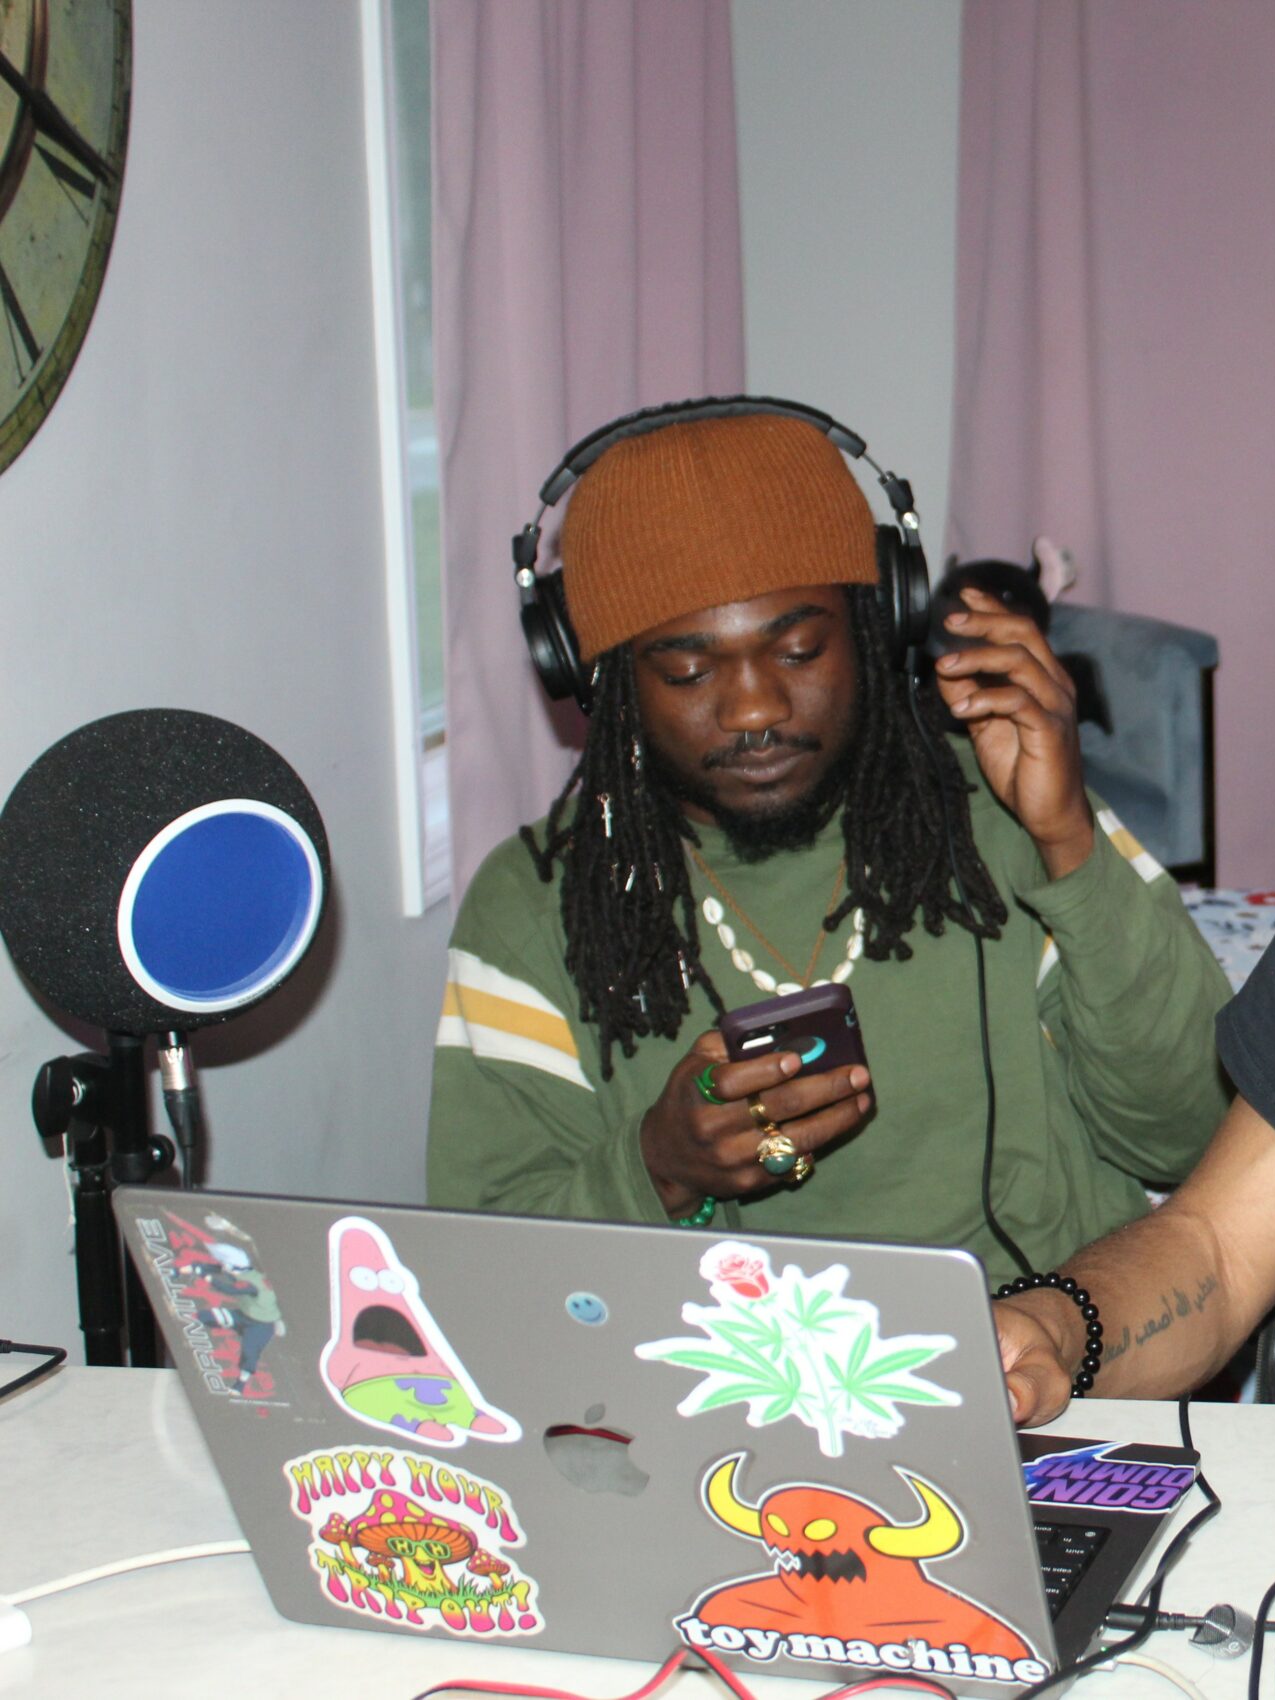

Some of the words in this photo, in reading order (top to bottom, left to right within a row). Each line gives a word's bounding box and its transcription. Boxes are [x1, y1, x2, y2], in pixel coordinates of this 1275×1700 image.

[290, 1450, 396, 1516] HAPPY
[403, 1455, 519, 1543] HOUR
[1031, 1478, 1181, 1510] GOIN
[314, 1548, 426, 1626] TRIP
[439, 1579, 538, 1633] OUT!
[680, 1615, 781, 1660] toy
[787, 1633, 1049, 1684] machine
